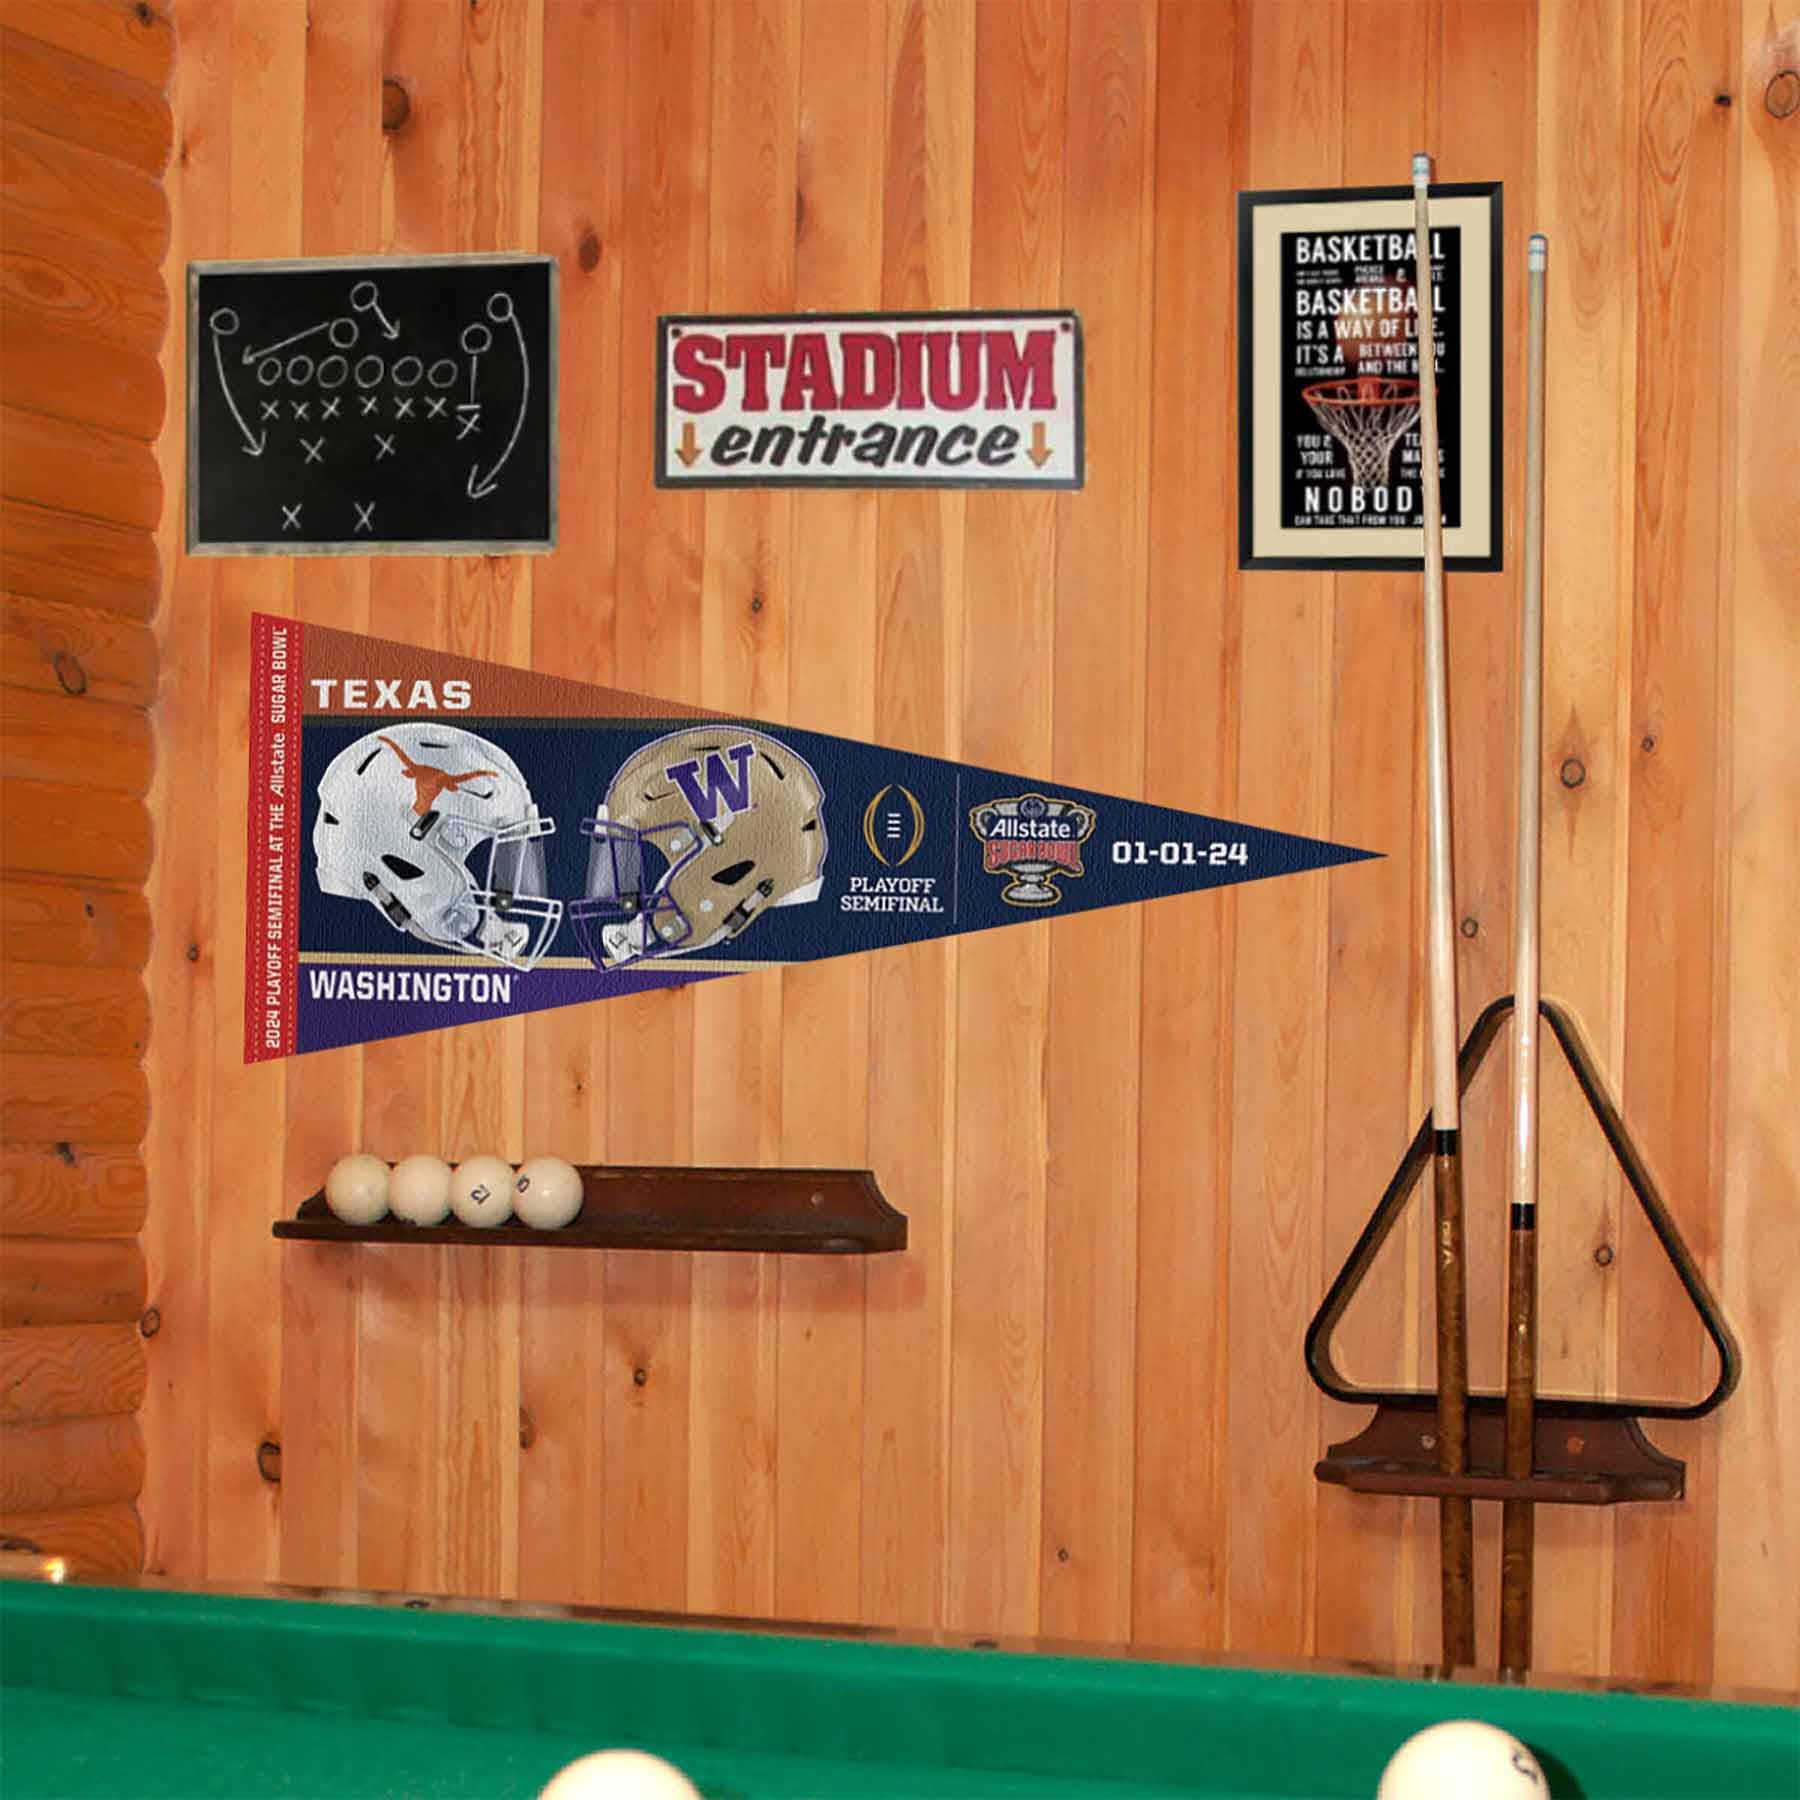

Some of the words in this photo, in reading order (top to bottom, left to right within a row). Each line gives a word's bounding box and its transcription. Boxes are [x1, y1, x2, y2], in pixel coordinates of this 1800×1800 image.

[1296, 232, 1445, 263] BASKETBAL
[1296, 286, 1445, 316] BASKETBAL
[1296, 320, 1312, 339] IS
[1317, 320, 1329, 339] A
[1334, 319, 1375, 338] WAY
[1379, 318, 1401, 337] OF
[1405, 317, 1445, 337] LIE.
[1296, 345, 1329, 364] IT'S
[1333, 344, 1345, 363] A
[1357, 360, 1383, 374] AND
[1386, 360, 1408, 373] THE
[672, 330, 1057, 413] STADIUM
[711, 415, 1020, 467] entrance
[1297, 435, 1321, 448] YOU
[1300, 451, 1333, 465] YOUR
[1305, 486, 1421, 513] NOBOD
[272, 627, 288, 670] BOWL
[271, 674, 287, 724] SUGAR
[311, 679, 472, 709] TEXAS
[270, 732, 286, 797] Allstate
[665, 741, 755, 821] W
[269, 803, 285, 830] THE
[989, 818, 1071, 838] Allstate
[269, 834, 284, 852] AT
[1112, 841, 1249, 865] 01-01-24
[268, 856, 284, 939] SEMIFINAL
[850, 877, 936, 893] PLAYOFF
[840, 895, 944, 912] SEMIFINAL
[266, 944, 282, 1006] PLAYOFF
[309, 970, 511, 1003] WASHINGTON
[266, 1009, 281, 1049] 2024
